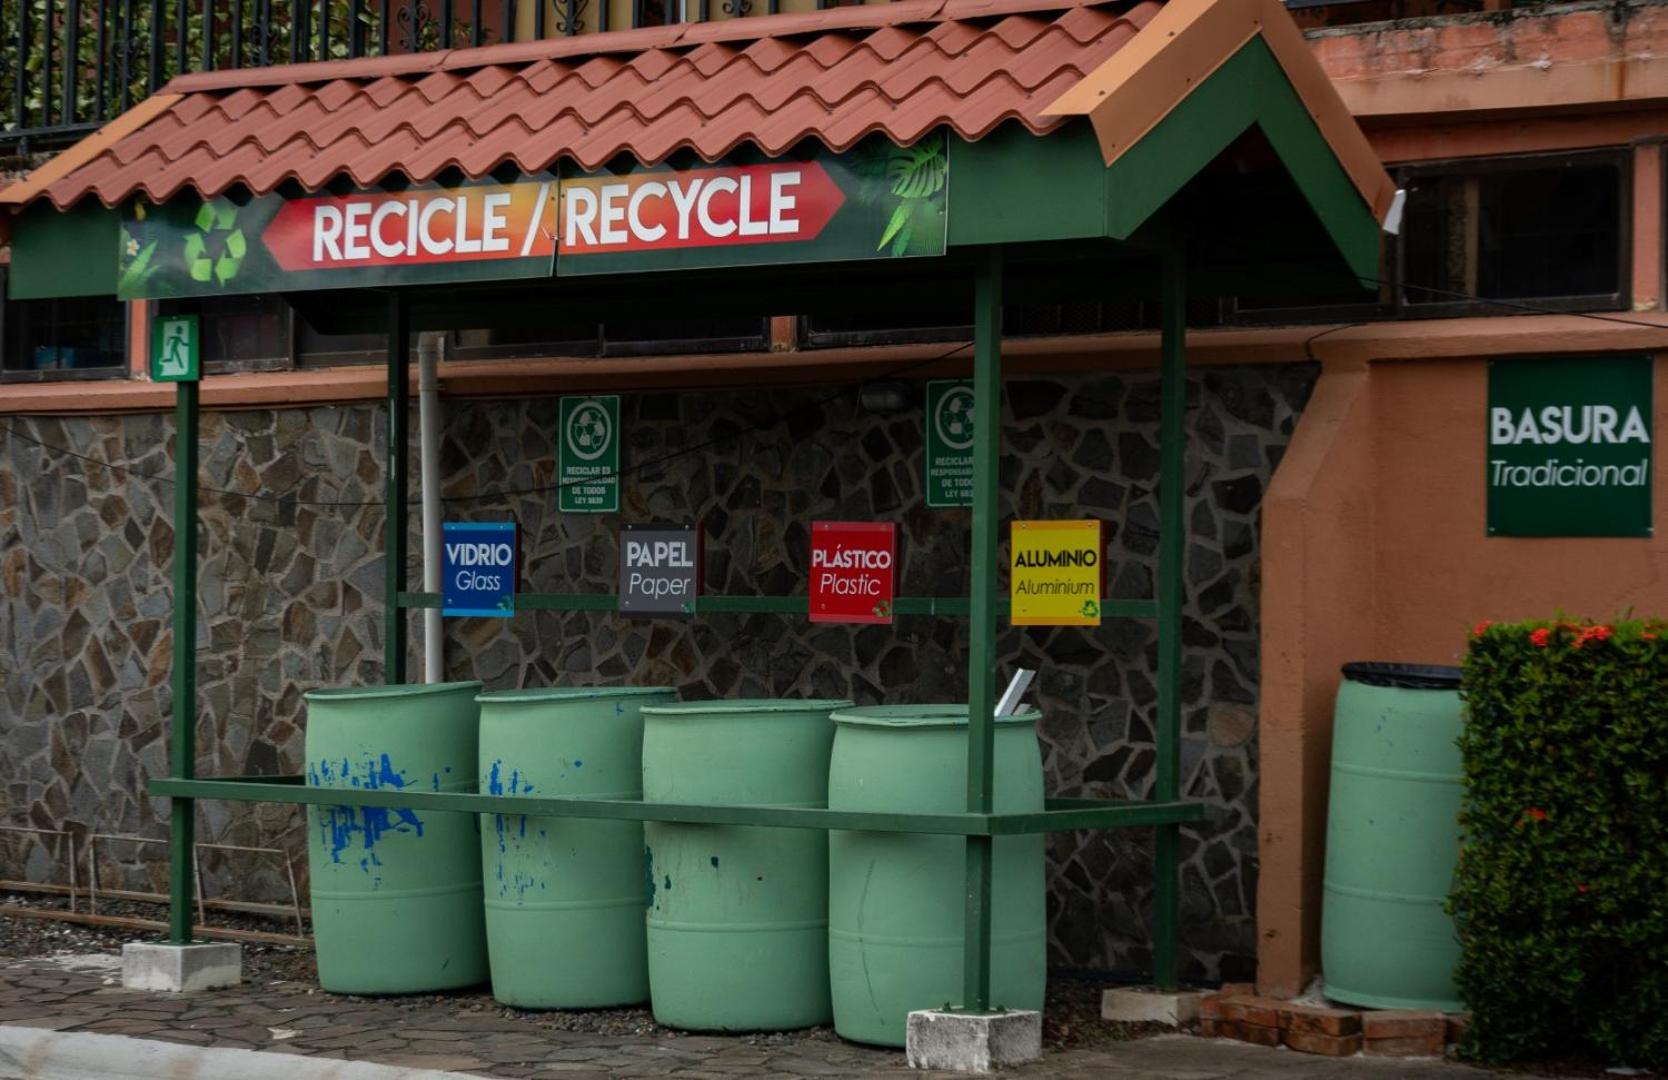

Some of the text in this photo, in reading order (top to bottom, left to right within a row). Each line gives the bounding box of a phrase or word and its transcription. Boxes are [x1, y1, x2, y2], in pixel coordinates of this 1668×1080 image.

[313, 171, 801, 262] RECICLE / RECYCLE
[1491, 405, 1650, 444] BASURA
[1491, 459, 1648, 486] Tradicional
[446, 543, 512, 566] VIDRIO
[626, 541, 693, 567] PAPEL
[812, 544, 891, 569] PLÁSTICO
[1015, 549, 1097, 568] ALUMINIO
[455, 570, 501, 591] Glass
[629, 573, 691, 600] Paper
[820, 573, 881, 596] Plastic
[1015, 578, 1094, 595] Aluminium
